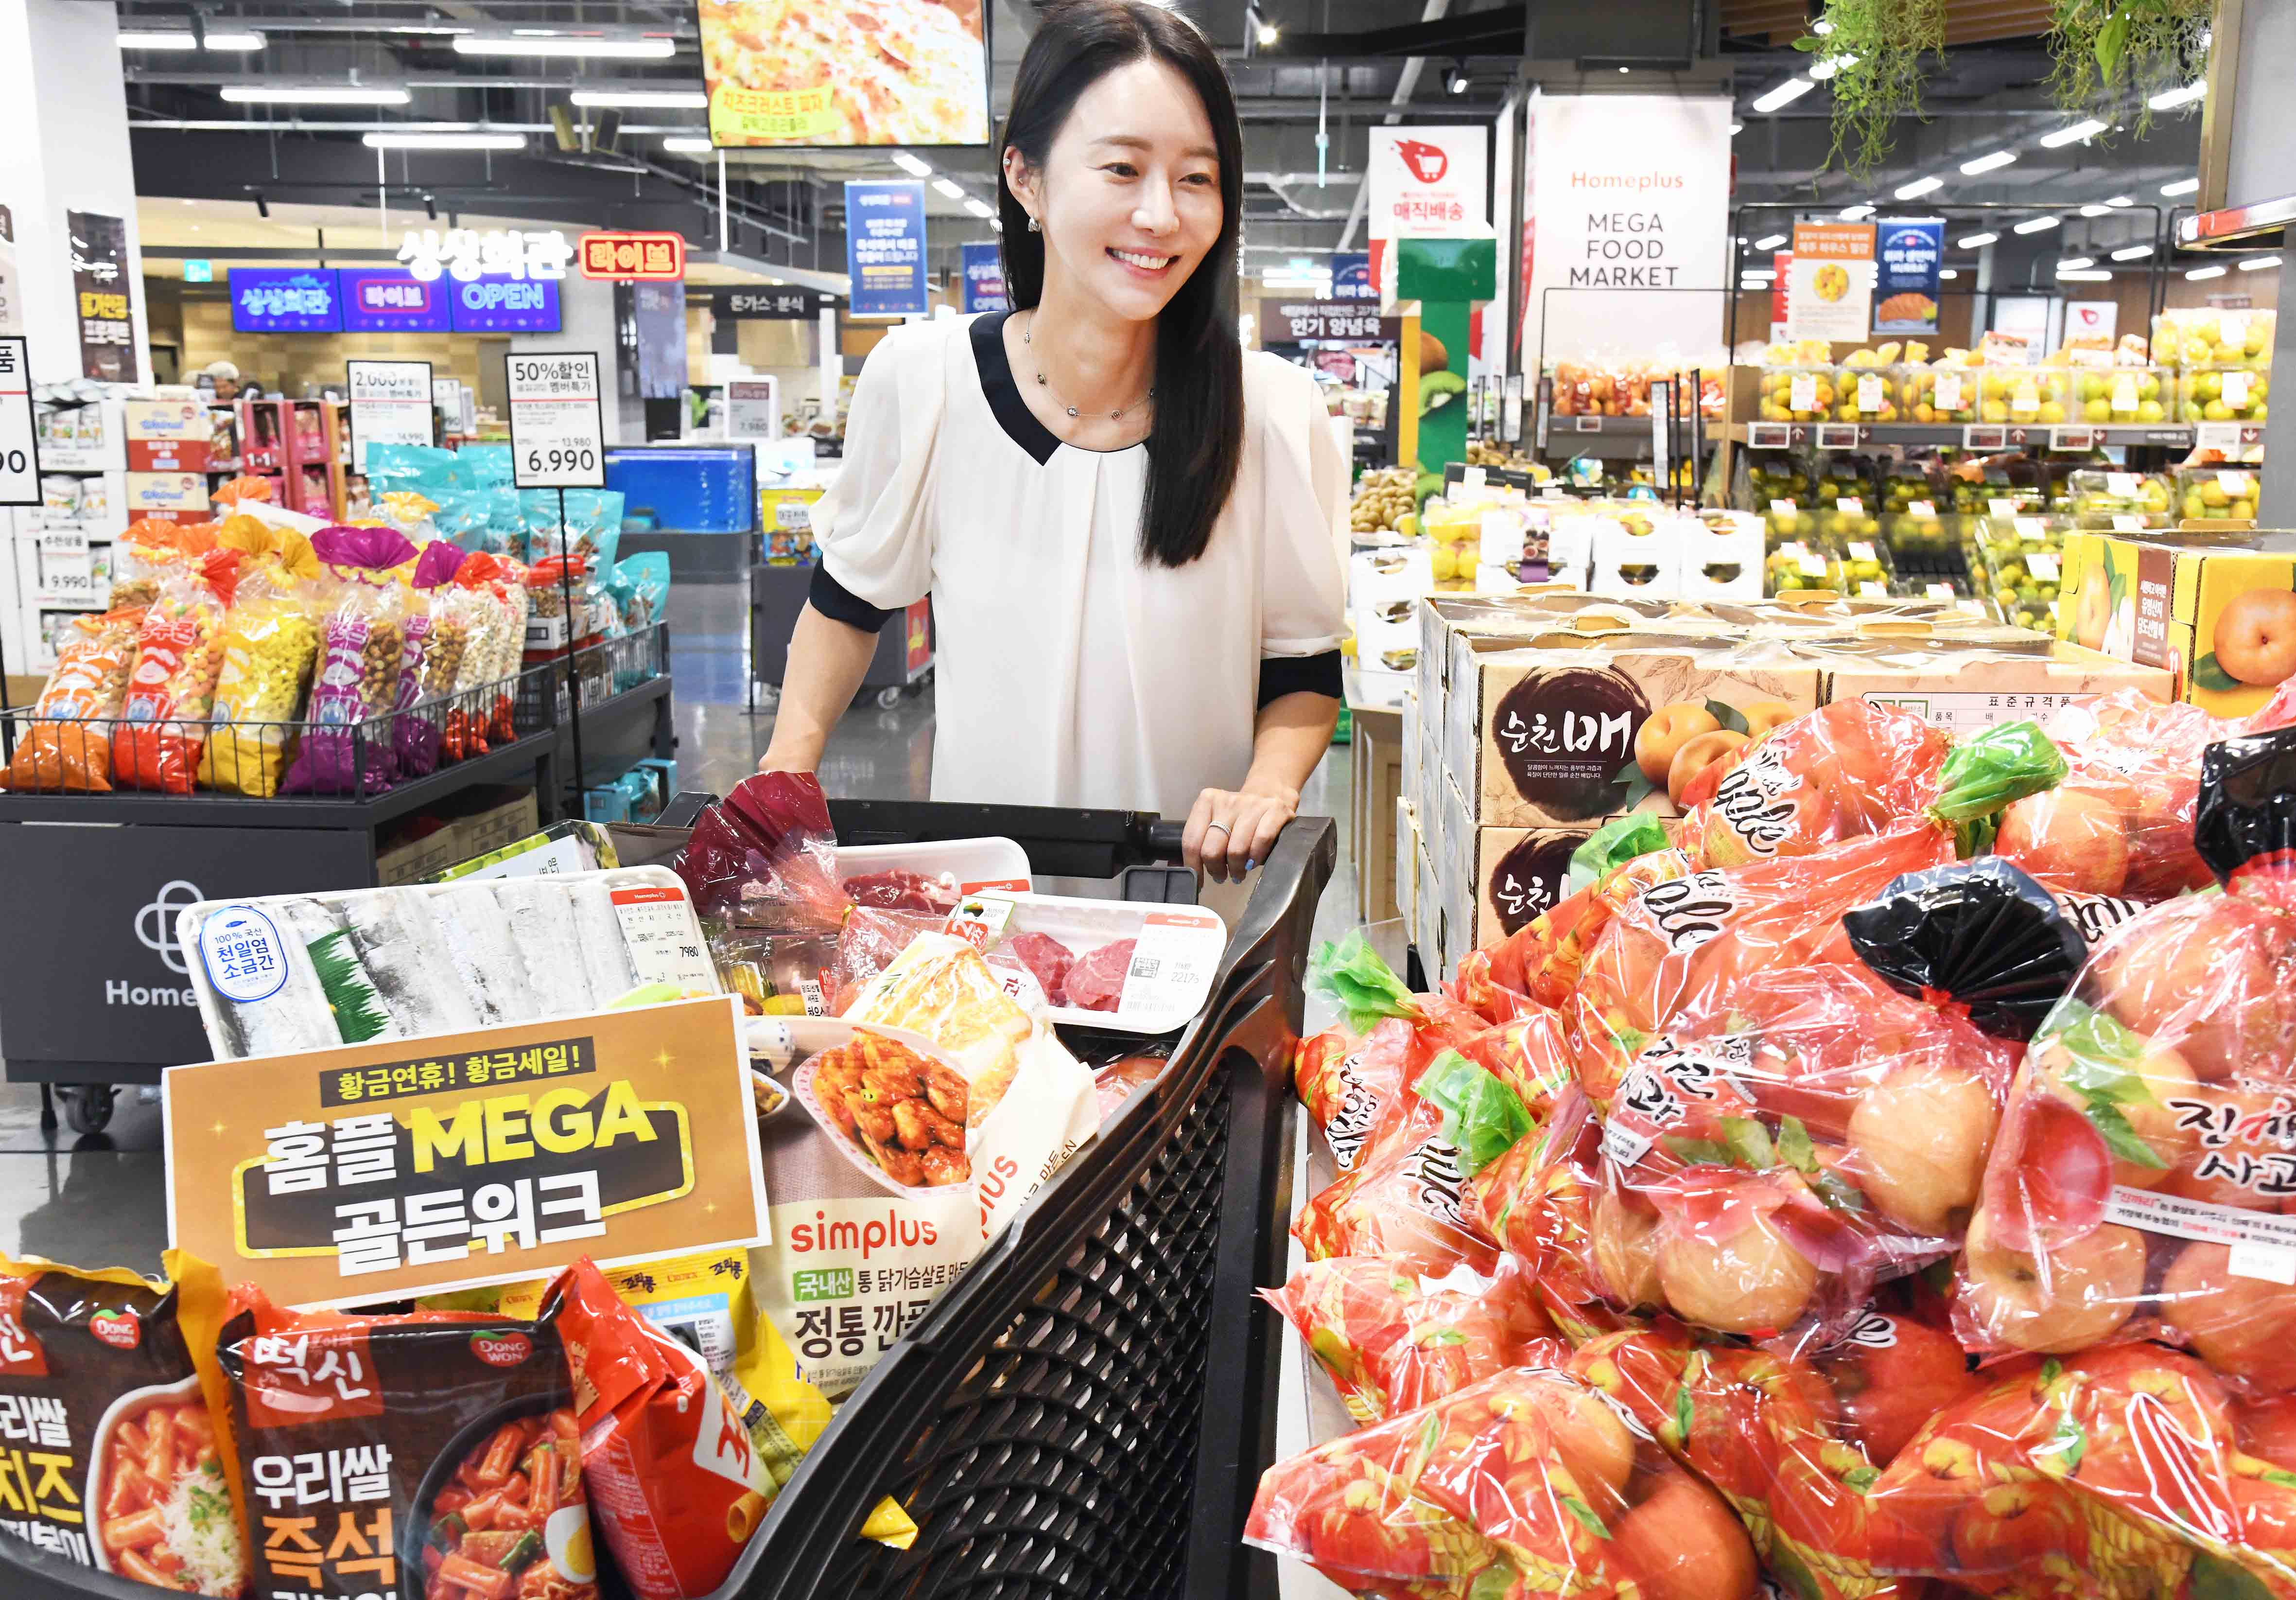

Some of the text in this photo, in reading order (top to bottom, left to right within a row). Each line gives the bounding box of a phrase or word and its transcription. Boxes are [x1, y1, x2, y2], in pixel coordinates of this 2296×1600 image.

[1572, 171, 1684, 191] Homeplus
[1392, 202, 1463, 221] 매직배송
[1588, 213, 1663, 233] MEGA
[590, 241, 673, 272] 라이브
[1587, 240, 1663, 259] FOOD
[1570, 267, 1679, 286] MARKET
[461, 282, 544, 310] OPEN
[1290, 317, 1381, 336] 인기 양념육
[529, 450, 594, 472] 6,990
[1985, 713, 1993, 721] 배
[214, 927, 263, 944] 100% 국산
[217, 937, 269, 963] 천일염
[679, 946, 699, 957] 7980
[224, 954, 275, 980] 소금간
[338, 1043, 582, 1101] 황금연휴! 황금세일!
[263, 1079, 658, 1196] 홈플 MEGA
[332, 1169, 608, 1278] 골든위크
[791, 1210, 938, 1260] simplus
[798, 1271, 851, 1298] 국내산
[857, 1270, 872, 1294] 통
[878, 1265, 945, 1292] 닭가슴살로
[795, 1305, 867, 1359] 정통
[480, 1340, 527, 1353] DONG
[487, 1351, 523, 1363] WON
[0, 1393, 72, 1448] 리쌀
[252, 1443, 393, 1510] 우리쌀
[262, 1507, 397, 1589] 즉석
